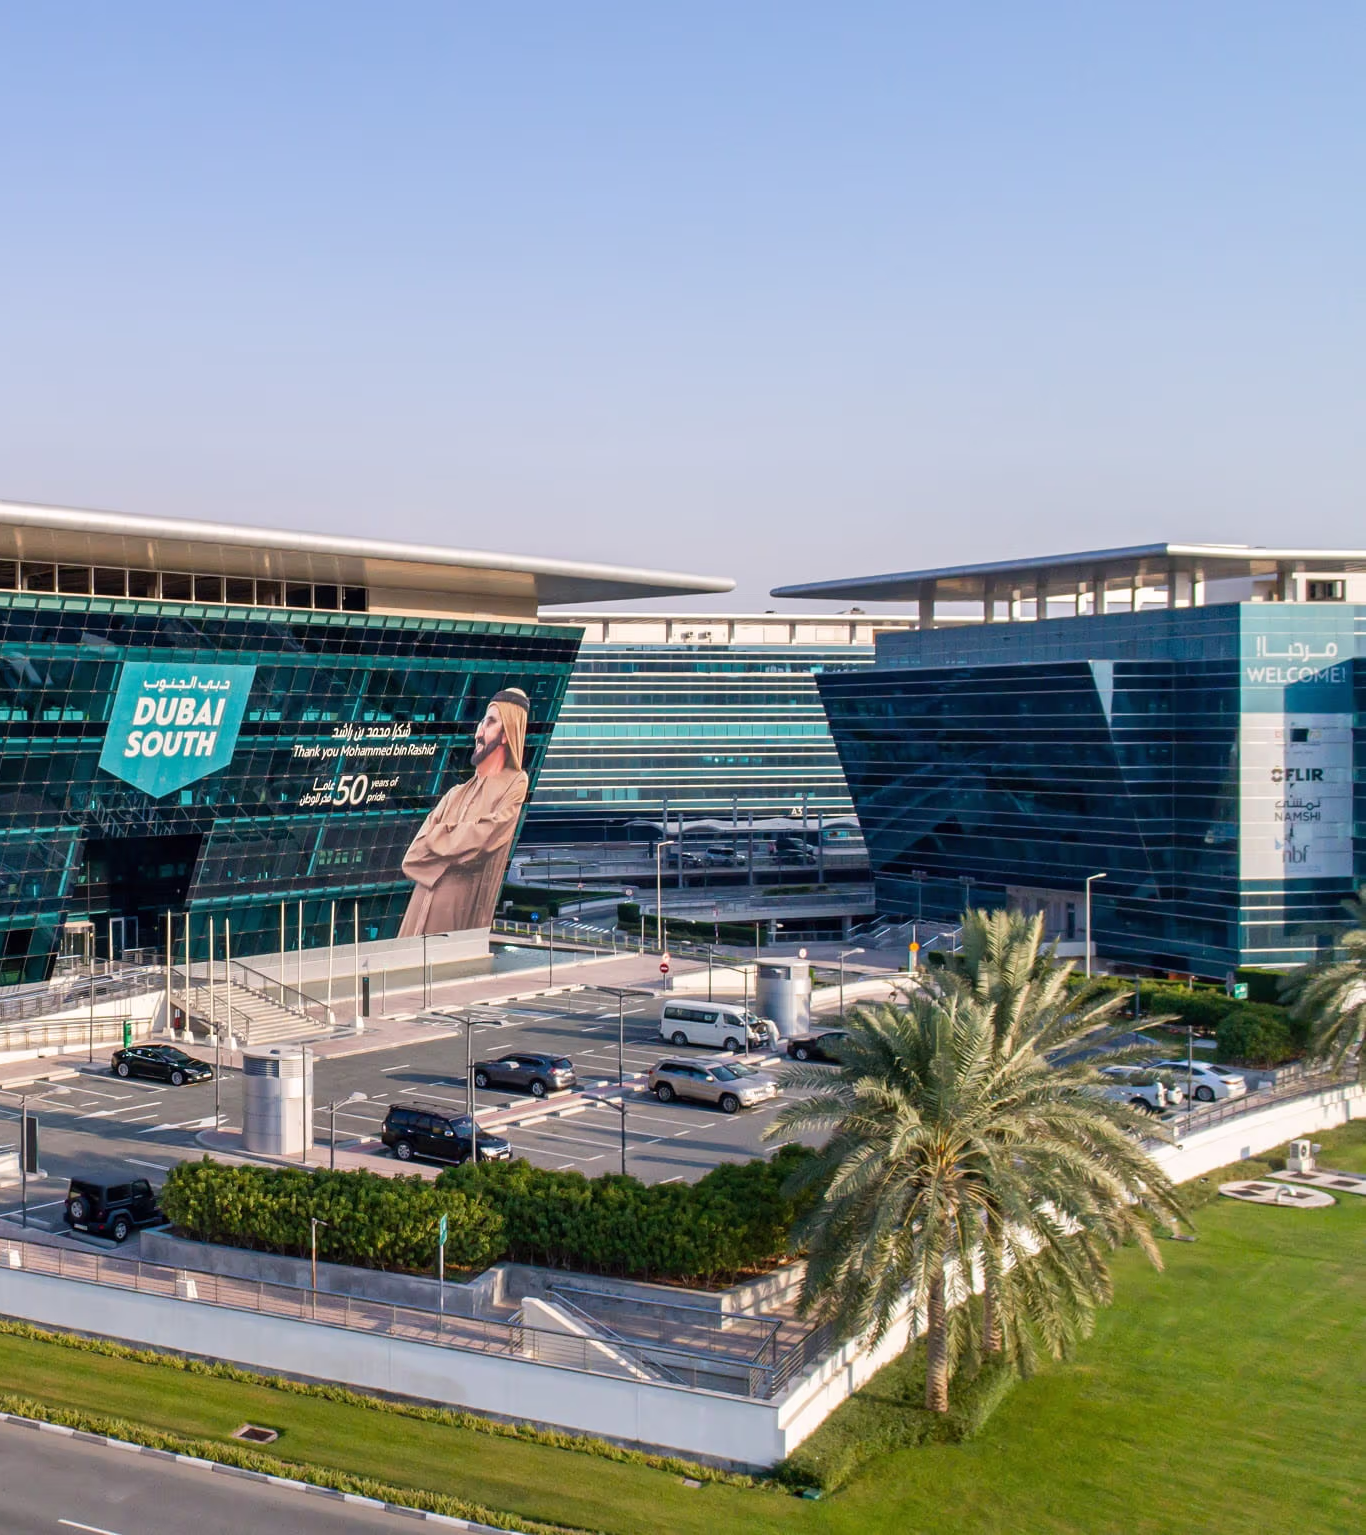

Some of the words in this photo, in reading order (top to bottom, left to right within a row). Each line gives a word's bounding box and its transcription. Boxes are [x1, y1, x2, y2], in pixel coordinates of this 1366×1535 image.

[1256, 635, 1338, 662] مرحبا!
[1246, 666, 1346, 683] WELCOME!
[143, 675, 198, 693] الجنوب
[198, 679, 231, 692] دبي
[132, 696, 227, 726] DUBAI
[331, 722, 354, 742] راشد
[353, 726, 365, 742] بن
[365, 727, 391, 738] محمد
[124, 731, 217, 758] SOUTH
[293, 744, 321, 758] Thank
[320, 747, 339, 761] you
[340, 743, 394, 758] Mohammed
[392, 743, 408, 756] bin
[407, 742, 437, 756] Rashid
[370, 778, 389, 790] years
[389, 775, 400, 787] of
[1285, 767, 1324, 782] FLIR
[332, 774, 369, 806] 50
[365, 791, 386, 805] pride
[1274, 811, 1321, 822] NAMSHI
[1282, 844, 1311, 864] nbf
